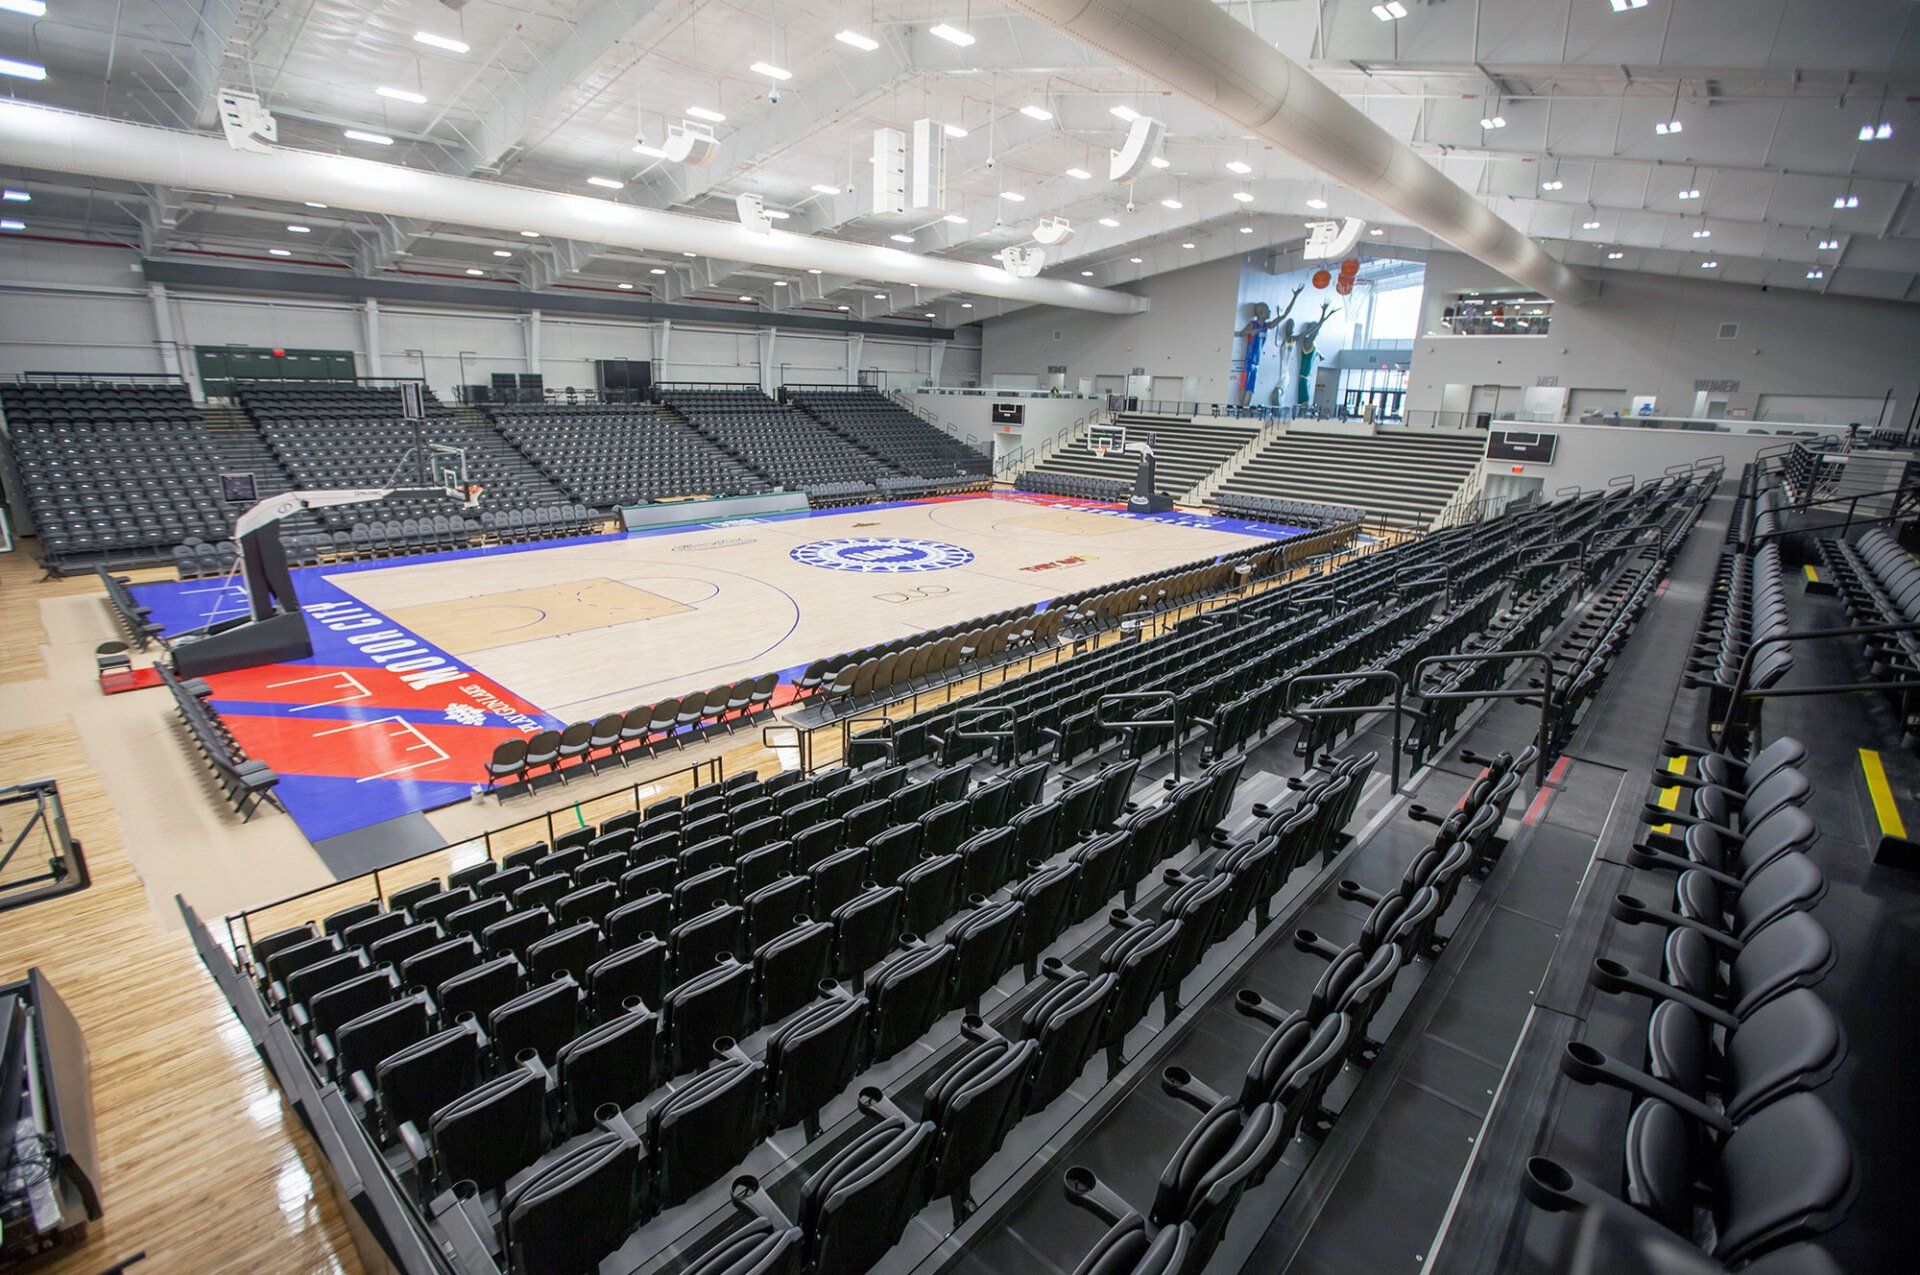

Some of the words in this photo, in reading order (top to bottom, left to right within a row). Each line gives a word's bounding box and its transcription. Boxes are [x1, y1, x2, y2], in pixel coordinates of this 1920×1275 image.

[1536, 375, 1559, 387] MEN
[1694, 379, 1741, 393] WOMEN
[301, 600, 384, 631] CITY
[346, 628, 470, 691] MOTOR
